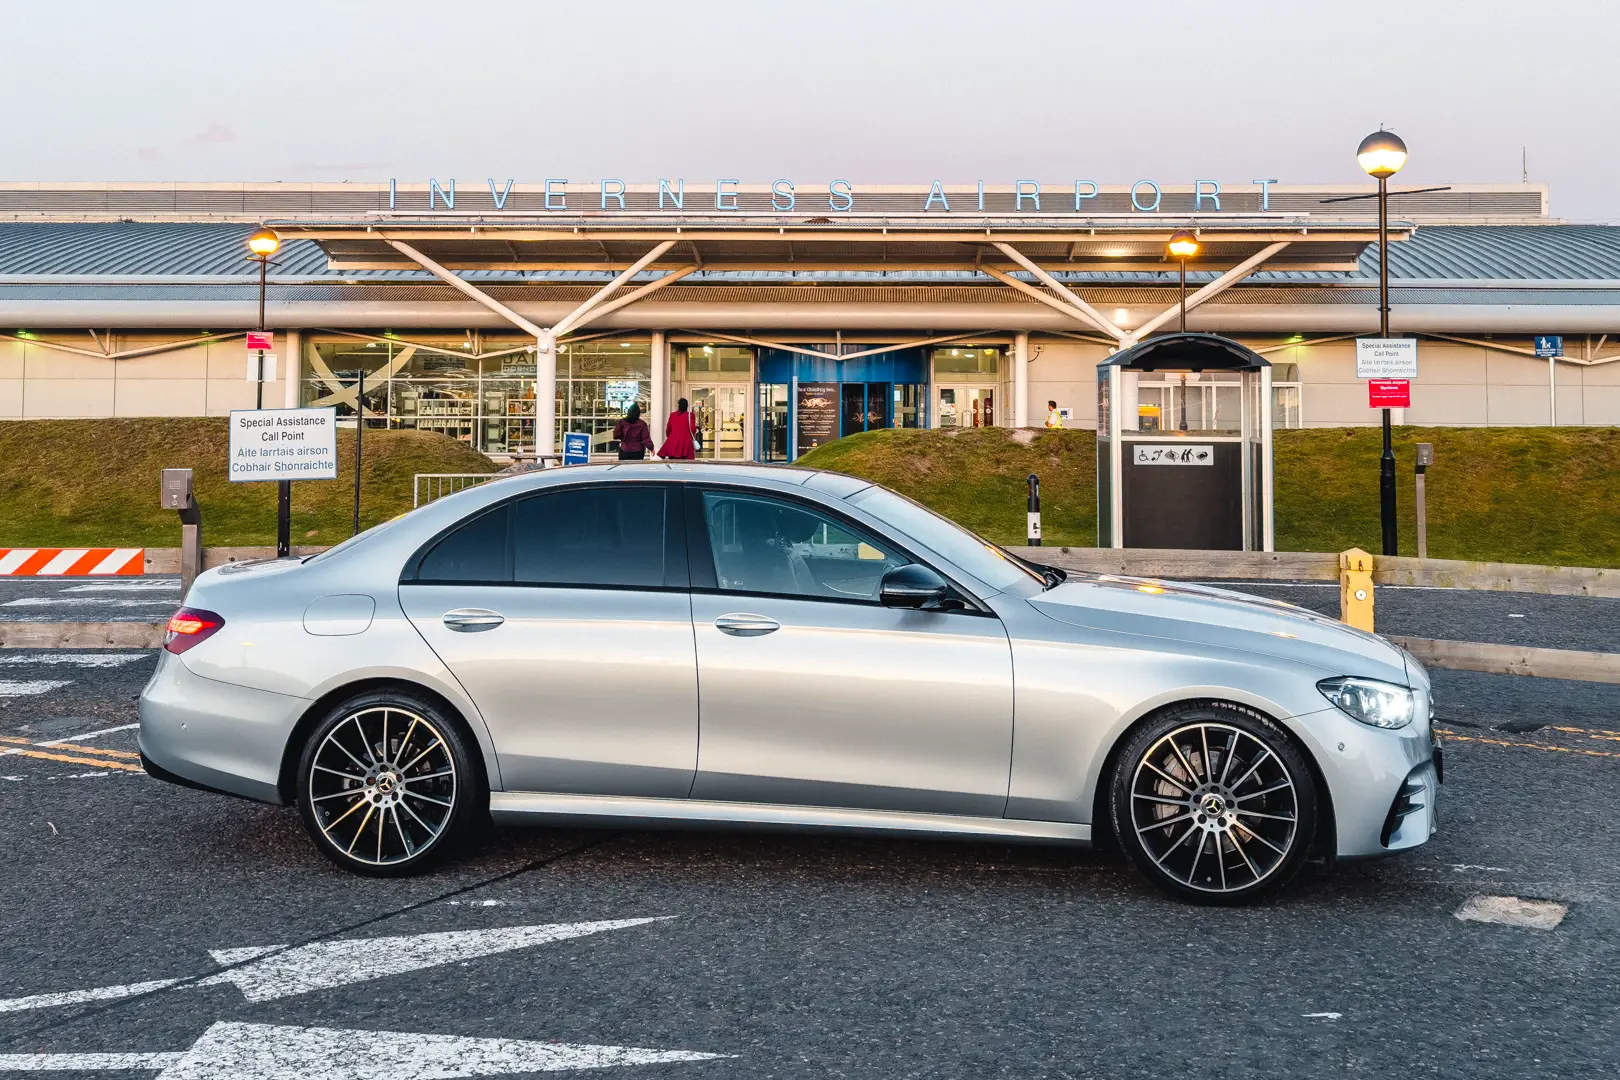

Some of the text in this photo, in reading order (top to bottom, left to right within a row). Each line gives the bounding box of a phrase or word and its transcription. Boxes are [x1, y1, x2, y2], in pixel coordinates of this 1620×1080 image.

[388, 178, 1279, 211] INVERNESS AIRPORT
[503, 353, 535, 364] JAI
[240, 416, 326, 430] Special Assistance
[261, 431, 305, 442] Call Point
[237, 447, 257, 457] Aite
[297, 446, 328, 456] airson
[232, 462, 271, 472] Cobhair
